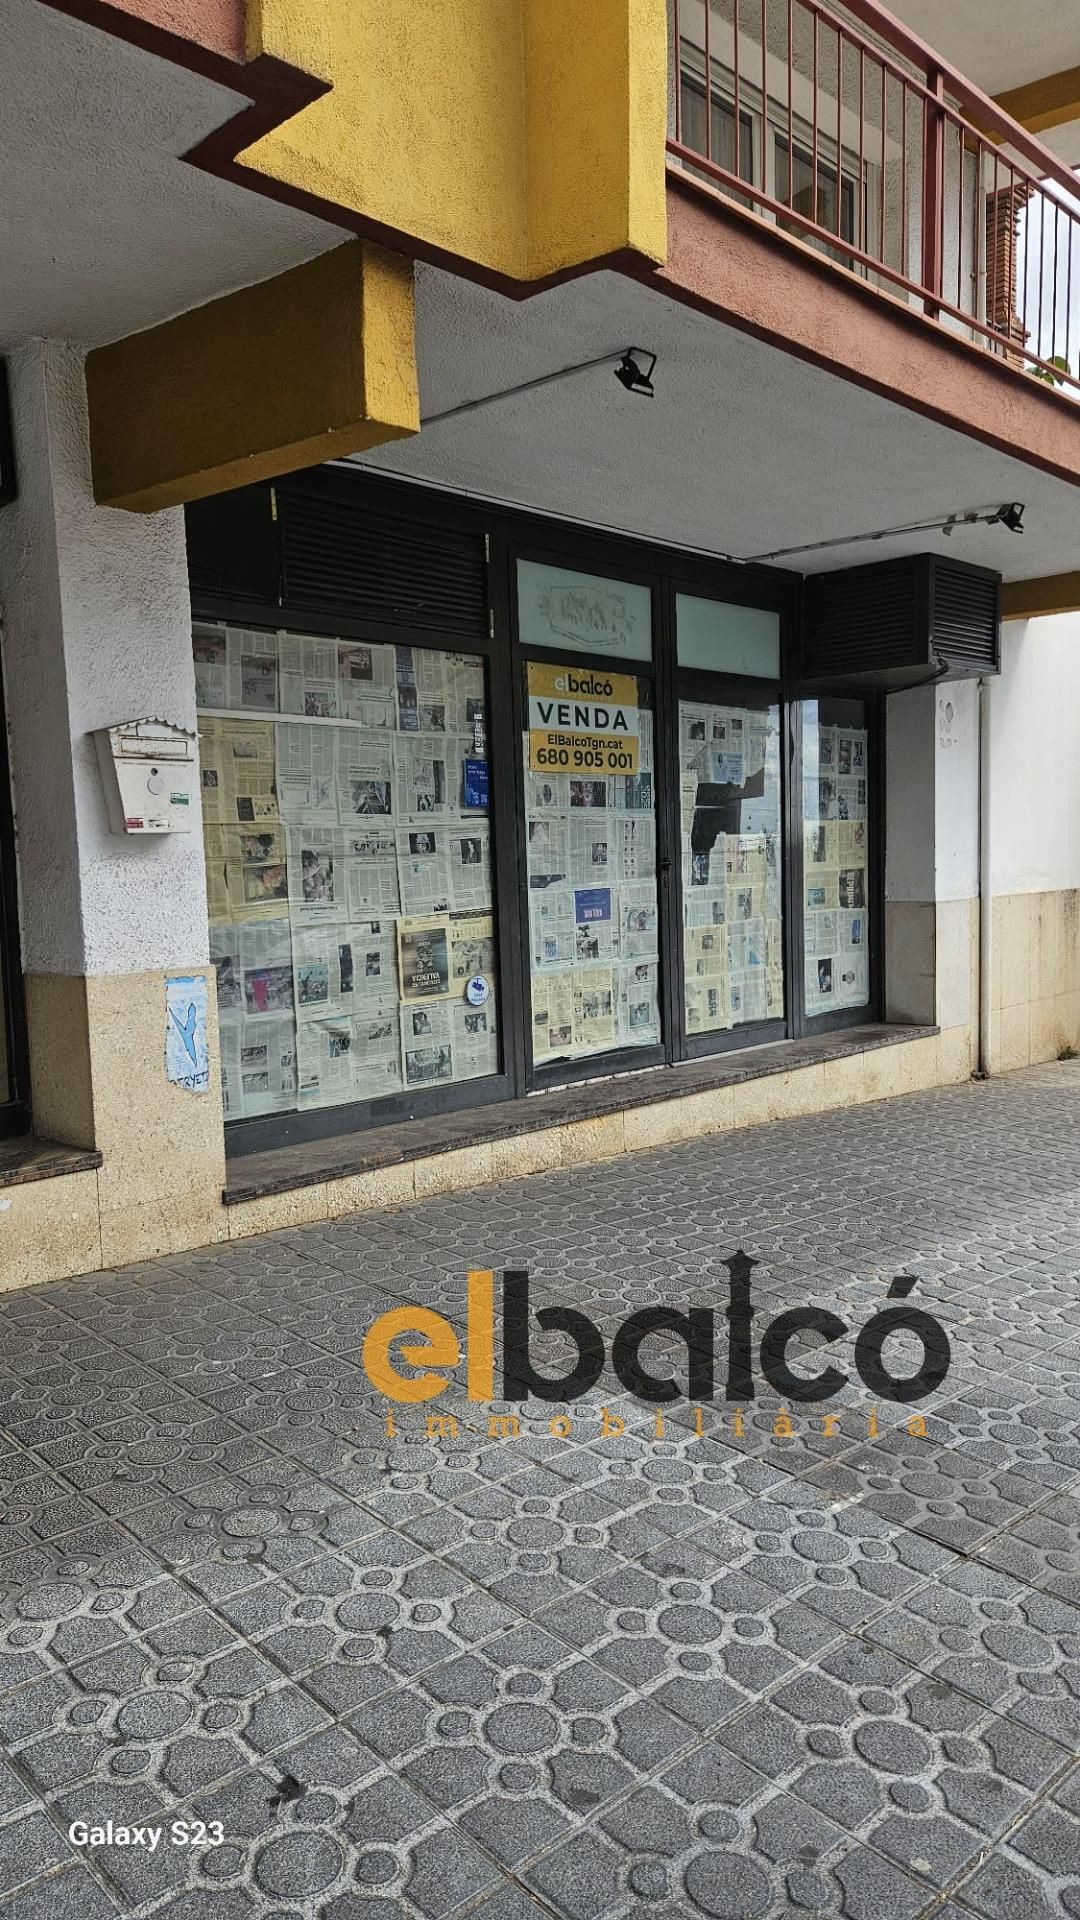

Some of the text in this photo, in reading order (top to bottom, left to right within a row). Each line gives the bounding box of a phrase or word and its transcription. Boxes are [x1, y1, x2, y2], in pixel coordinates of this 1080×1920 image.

[554, 673, 613, 697] elbalcó
[537, 702, 629, 731] VENDA
[547, 734, 623, 750] ElBalcoTgn.cat
[536, 748, 633, 769] 680 905 001
